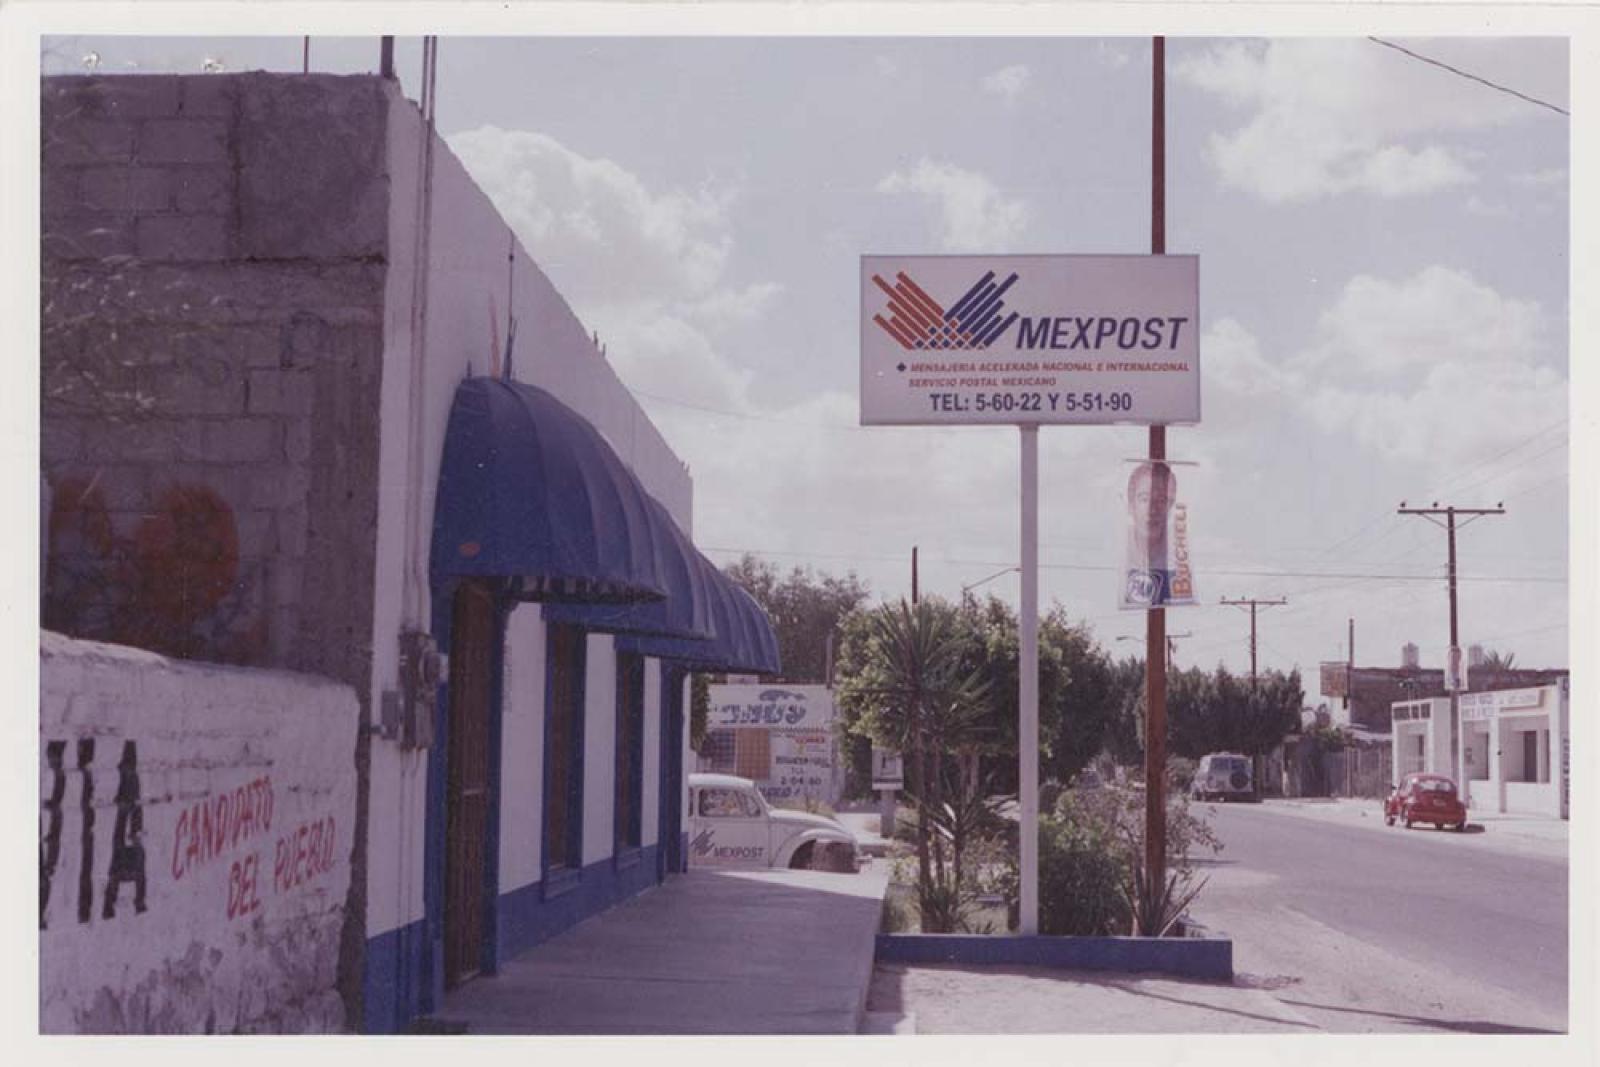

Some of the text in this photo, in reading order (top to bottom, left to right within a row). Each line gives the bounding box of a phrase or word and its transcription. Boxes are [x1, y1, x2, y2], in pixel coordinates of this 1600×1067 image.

[1015, 316, 1188, 350] MEXPOST
[910, 361, 1190, 372] MENSAJERIA ACELERADA NACIONAL E INTERNACIONAL
[909, 377, 1056, 387] SERVICIO POSTAL MEXICANO
[929, 392, 1132, 411] TEL: 5-60-22 Y 5-51-90
[172, 775, 274, 880] CANDIDATO
[226, 852, 262, 921] DEL
